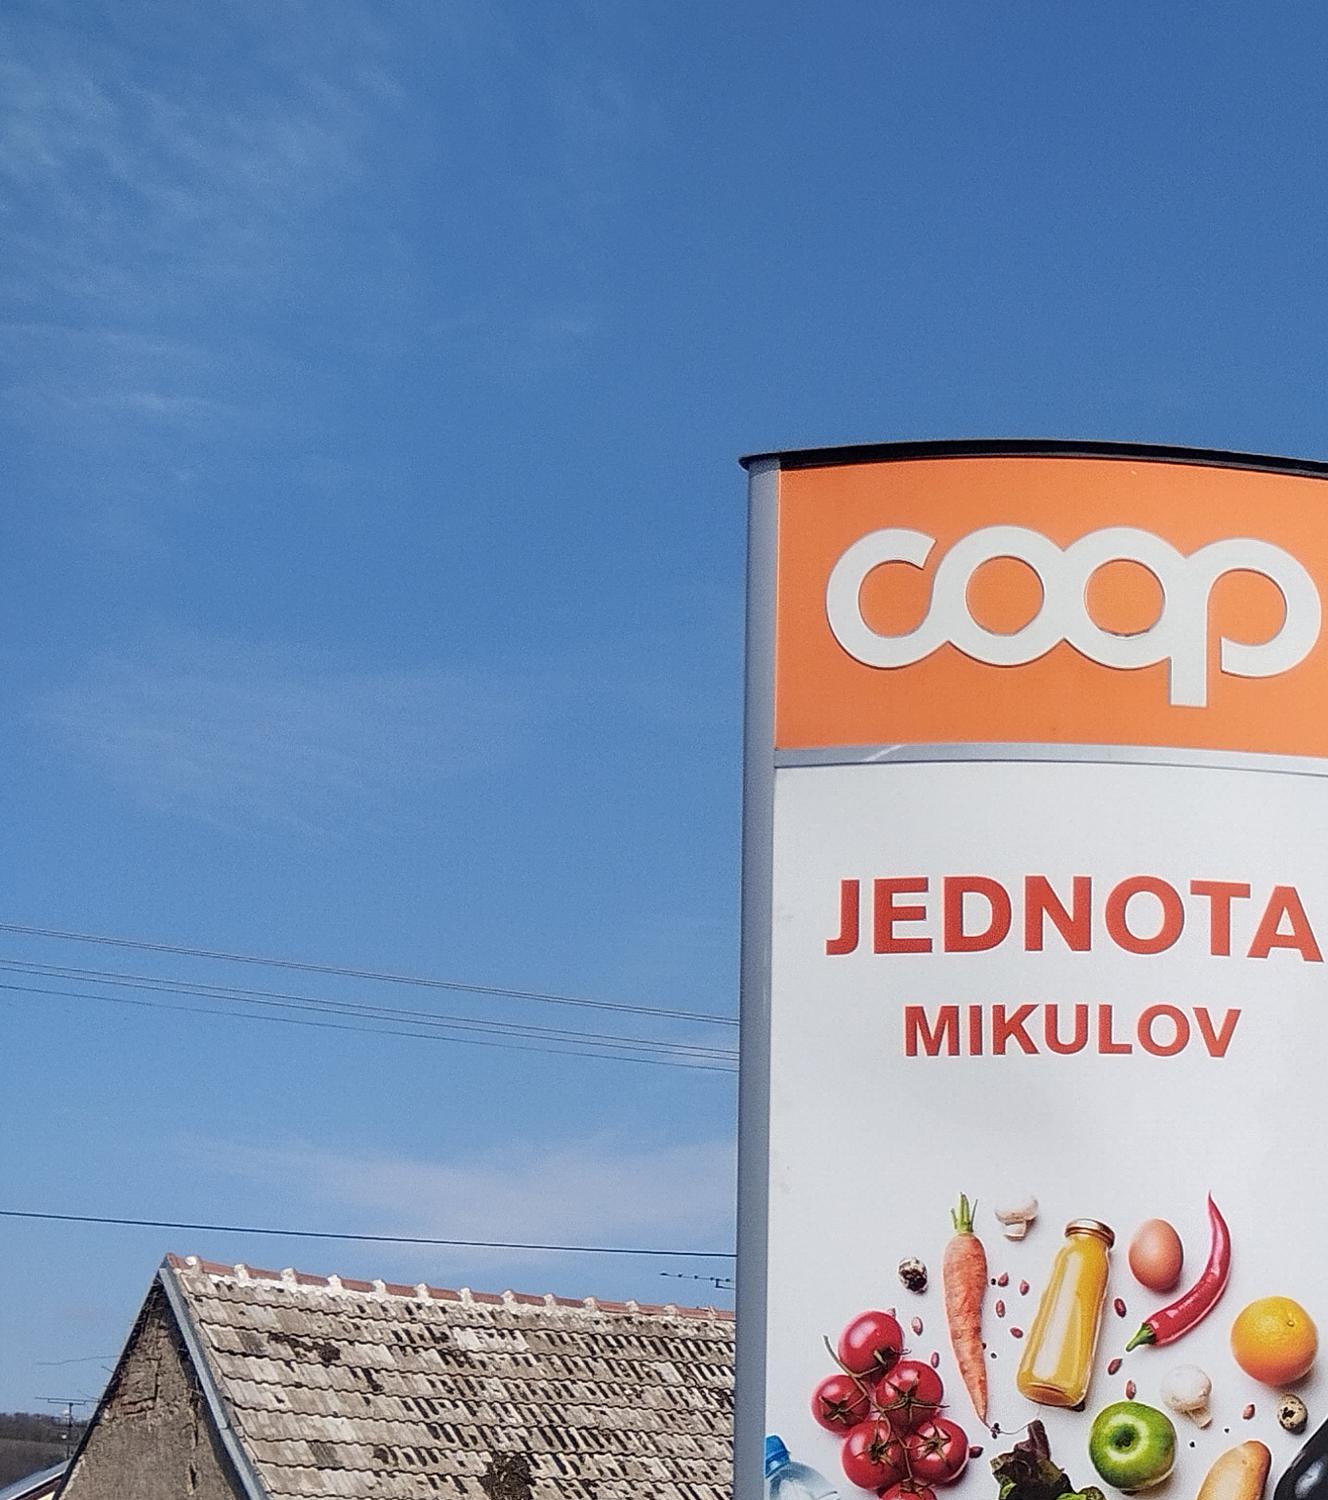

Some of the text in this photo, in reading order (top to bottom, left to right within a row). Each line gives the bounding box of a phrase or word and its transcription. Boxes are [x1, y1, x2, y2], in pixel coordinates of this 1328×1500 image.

[825, 524, 1323, 709] coop
[825, 874, 1324, 963] JEDNOTA
[904, 1003, 1241, 1058] MIKULOV
